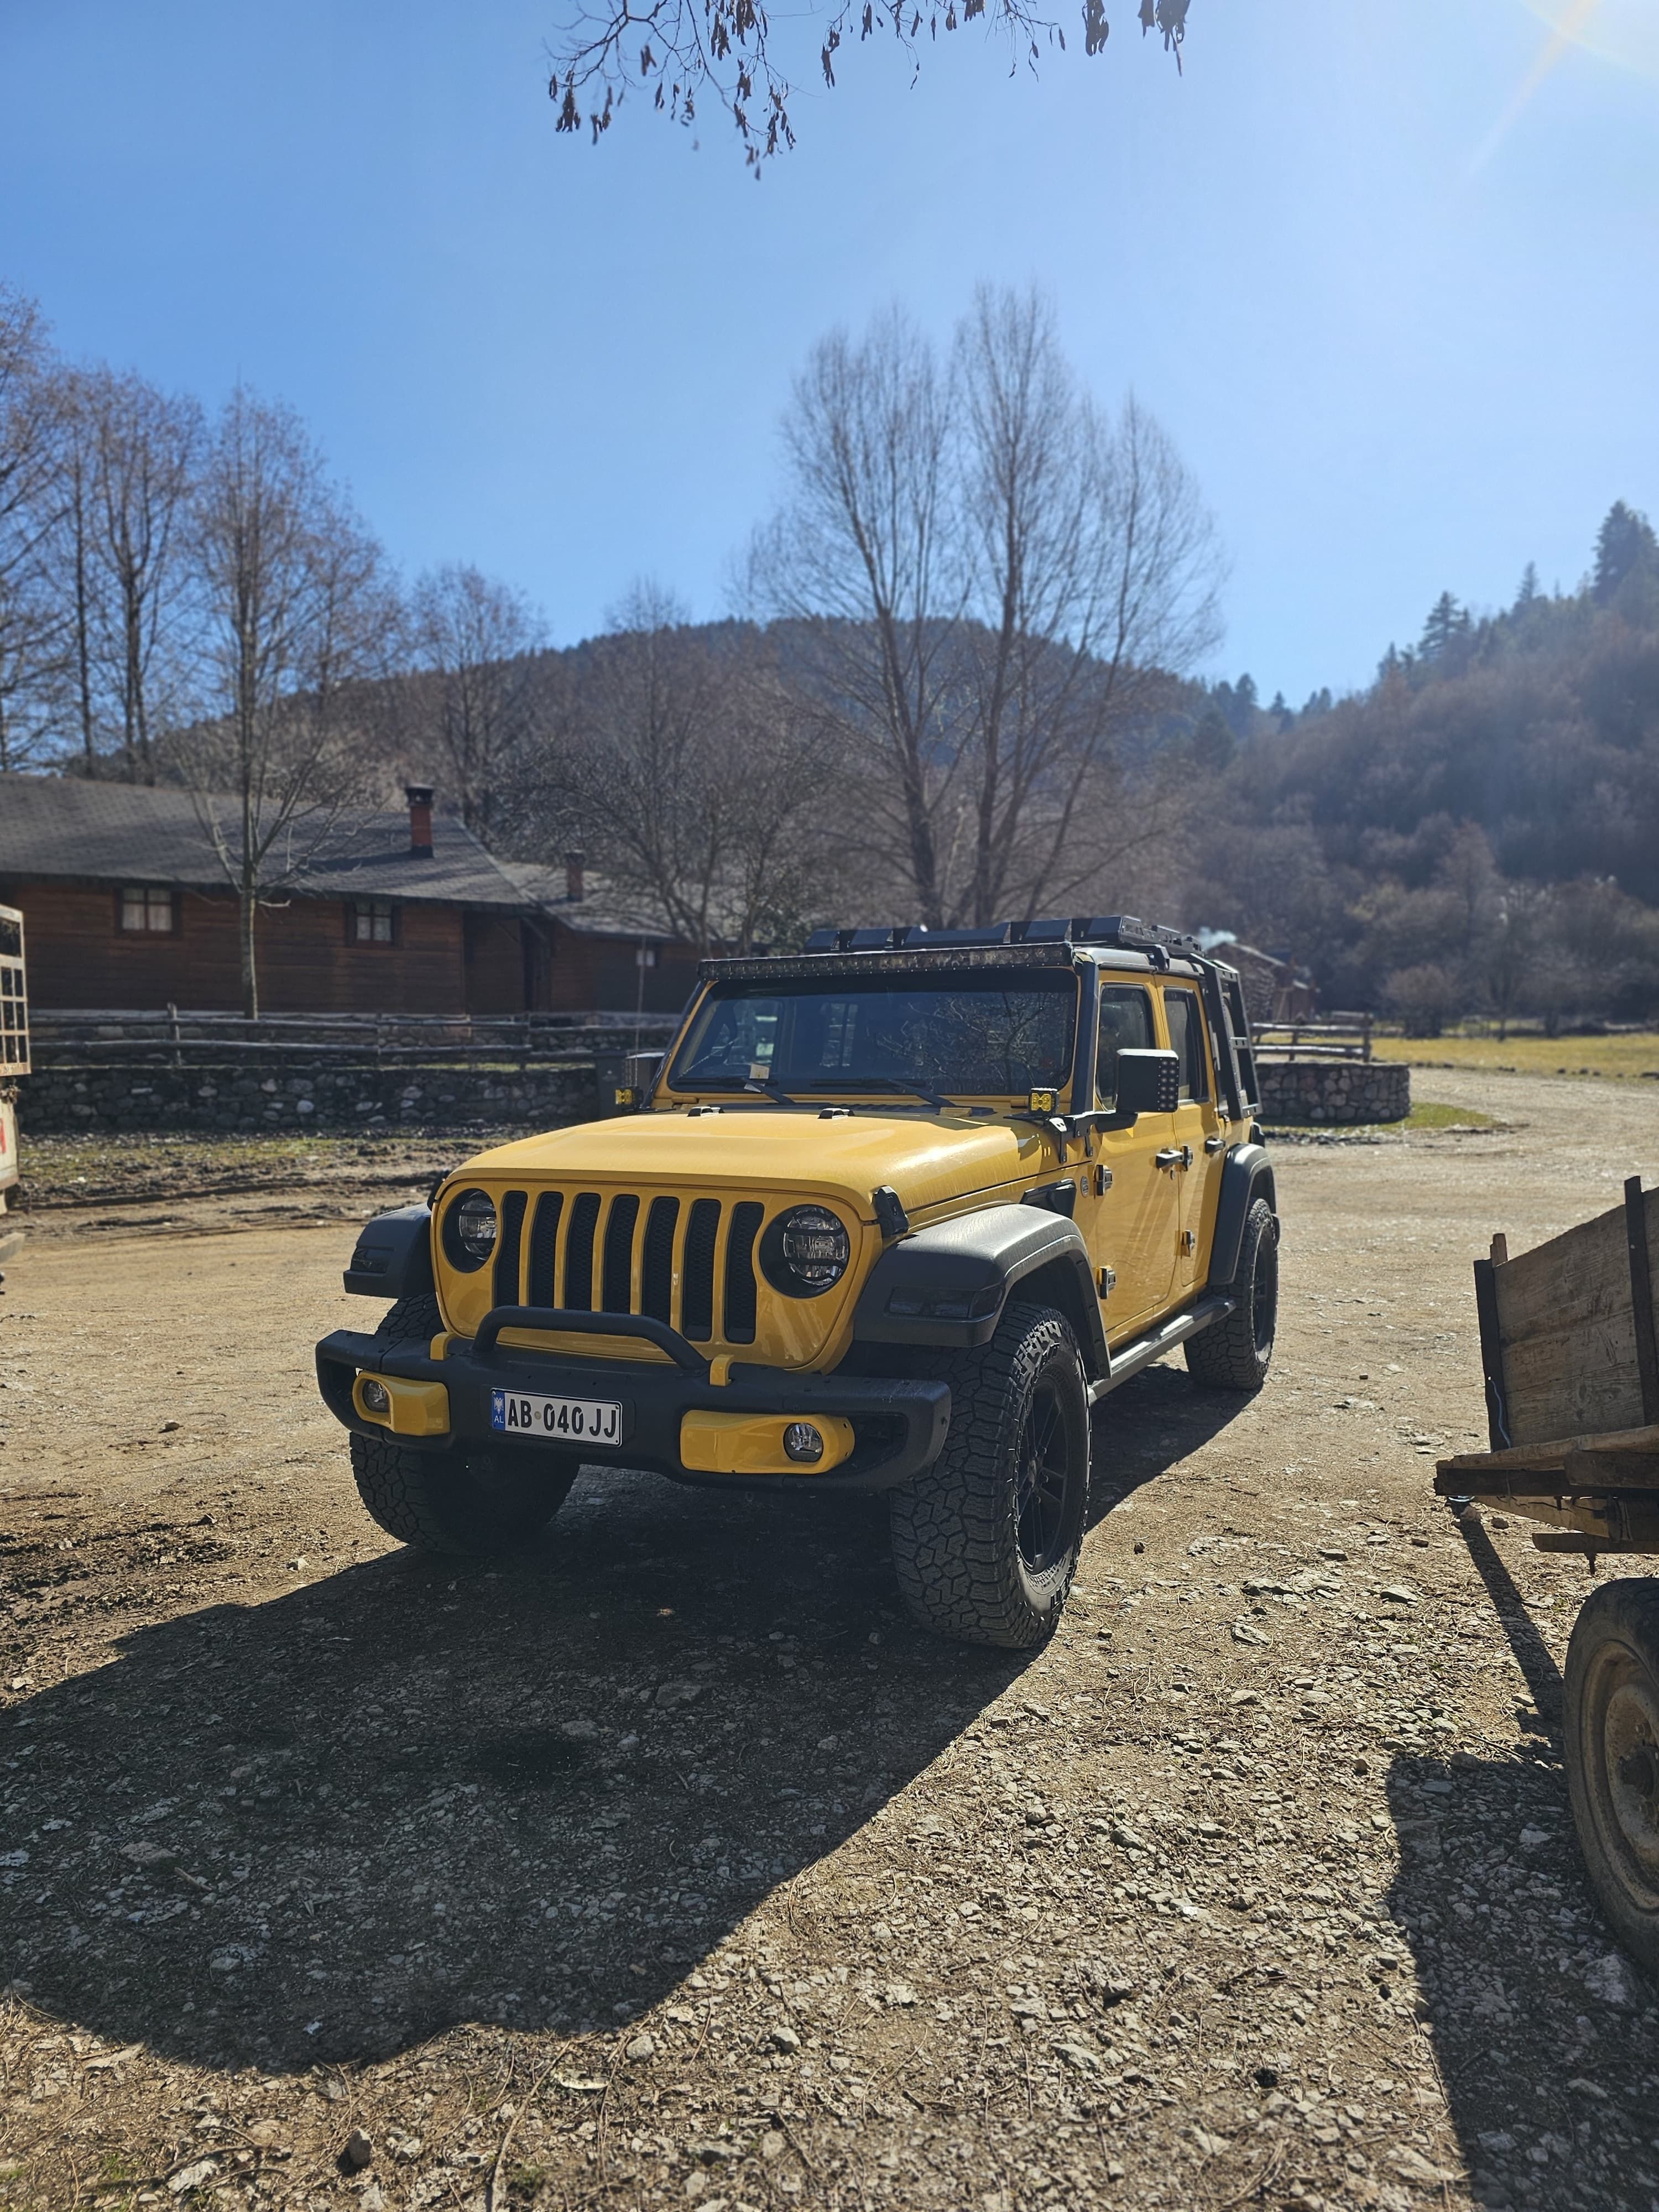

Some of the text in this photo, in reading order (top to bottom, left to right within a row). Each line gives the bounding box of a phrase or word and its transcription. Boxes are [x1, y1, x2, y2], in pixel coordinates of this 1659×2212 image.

[494, 1415, 504, 1423] AL
[508, 1399, 616, 1438] AB 040 JJ
